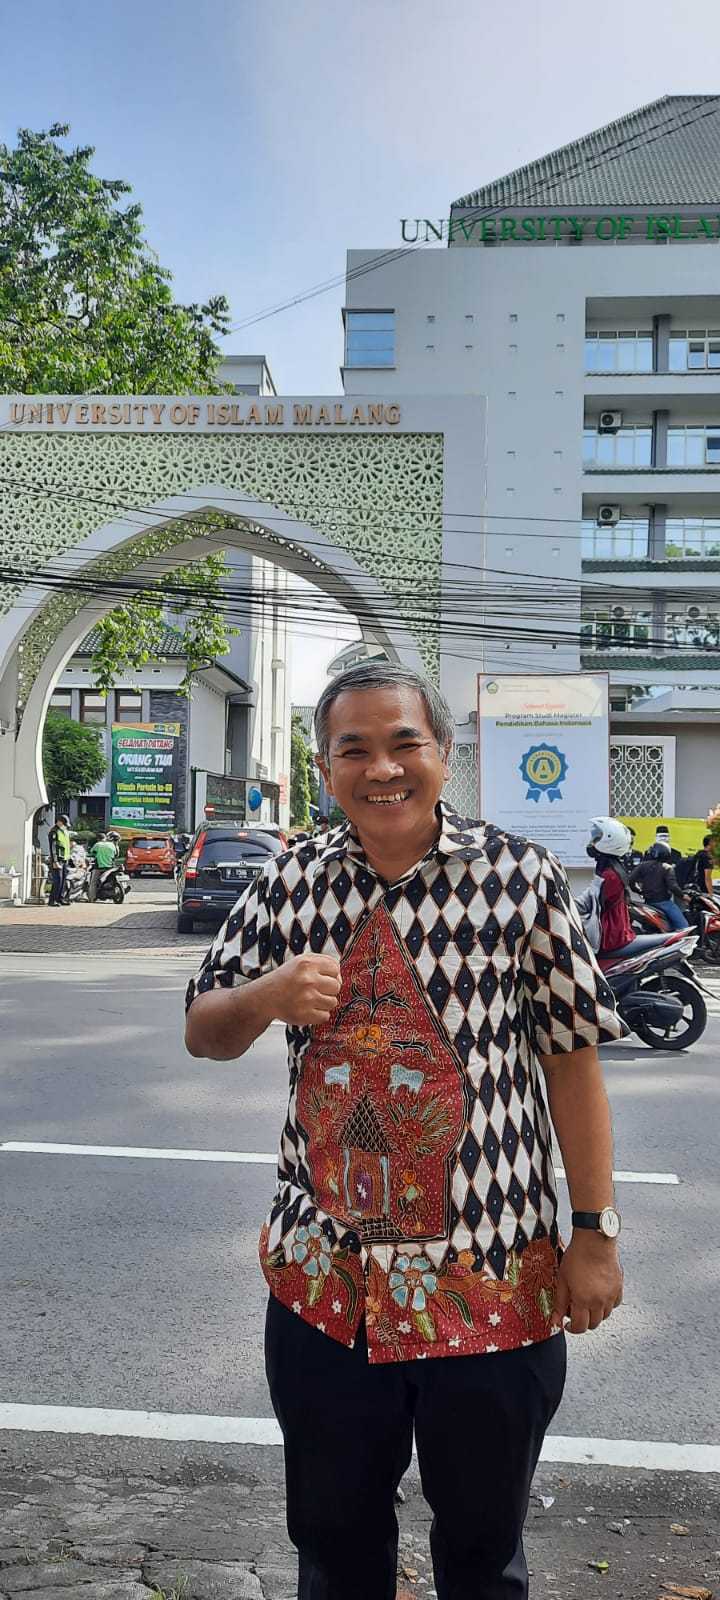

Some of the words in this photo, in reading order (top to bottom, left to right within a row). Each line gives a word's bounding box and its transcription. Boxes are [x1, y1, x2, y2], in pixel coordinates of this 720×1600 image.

[400, 217, 589, 242] UNIVERSITY
[596, 216, 634, 241] OF
[646, 214, 720, 241] ISLA
[9, 403, 165, 426] UNIVERSITY
[169, 403, 201, 426] OF
[206, 403, 284, 426] ISLAM
[292, 403, 402, 426] MALANG
[118, 753, 153, 766] ORANG
[154, 753, 173, 766] TUA
